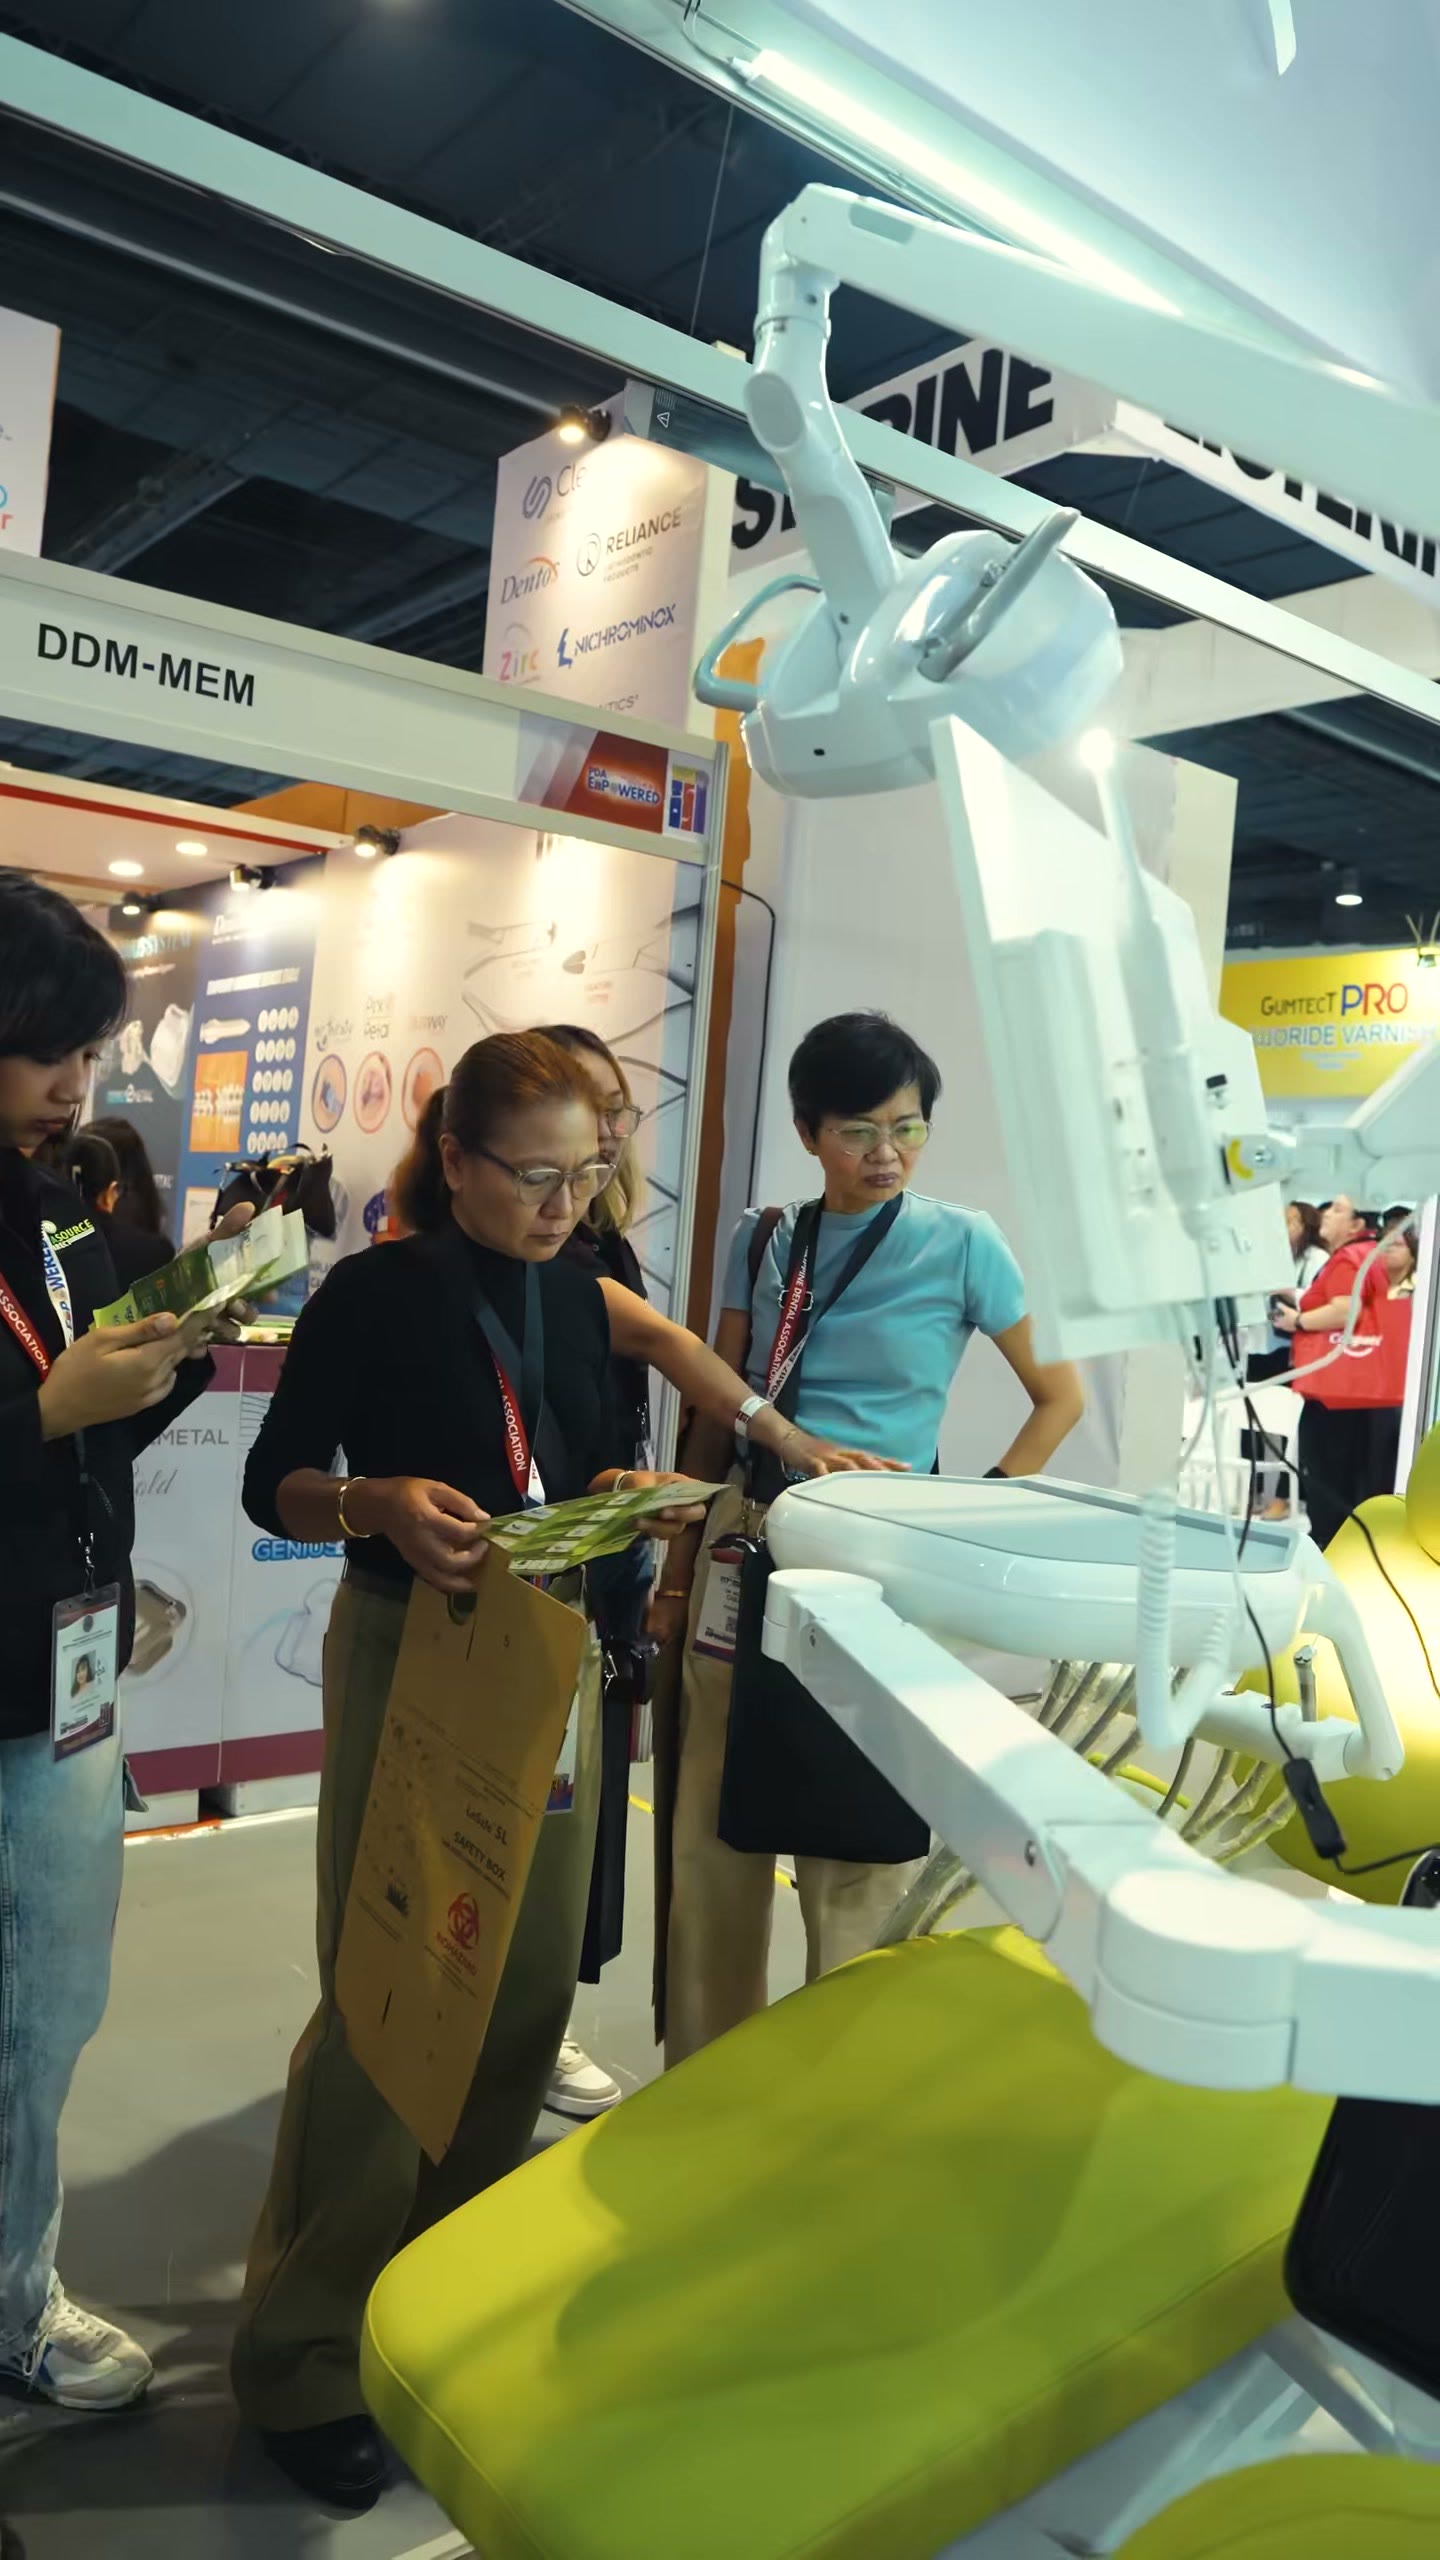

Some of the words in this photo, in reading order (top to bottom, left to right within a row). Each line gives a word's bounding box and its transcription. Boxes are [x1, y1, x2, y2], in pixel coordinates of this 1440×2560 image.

[607, 506, 683, 555] RELIANCE
[38, 623, 255, 707] DDM-MEM
[1341, 983, 1408, 1016] PRO
[783, 1287, 803, 1321] DENTAL
[151, 1428, 230, 1446] METAL
[501, 1394, 528, 1472] ASSOCIATION
[453, 1831, 486, 1864] SAFETY
[486, 1857, 506, 1881] BOX
